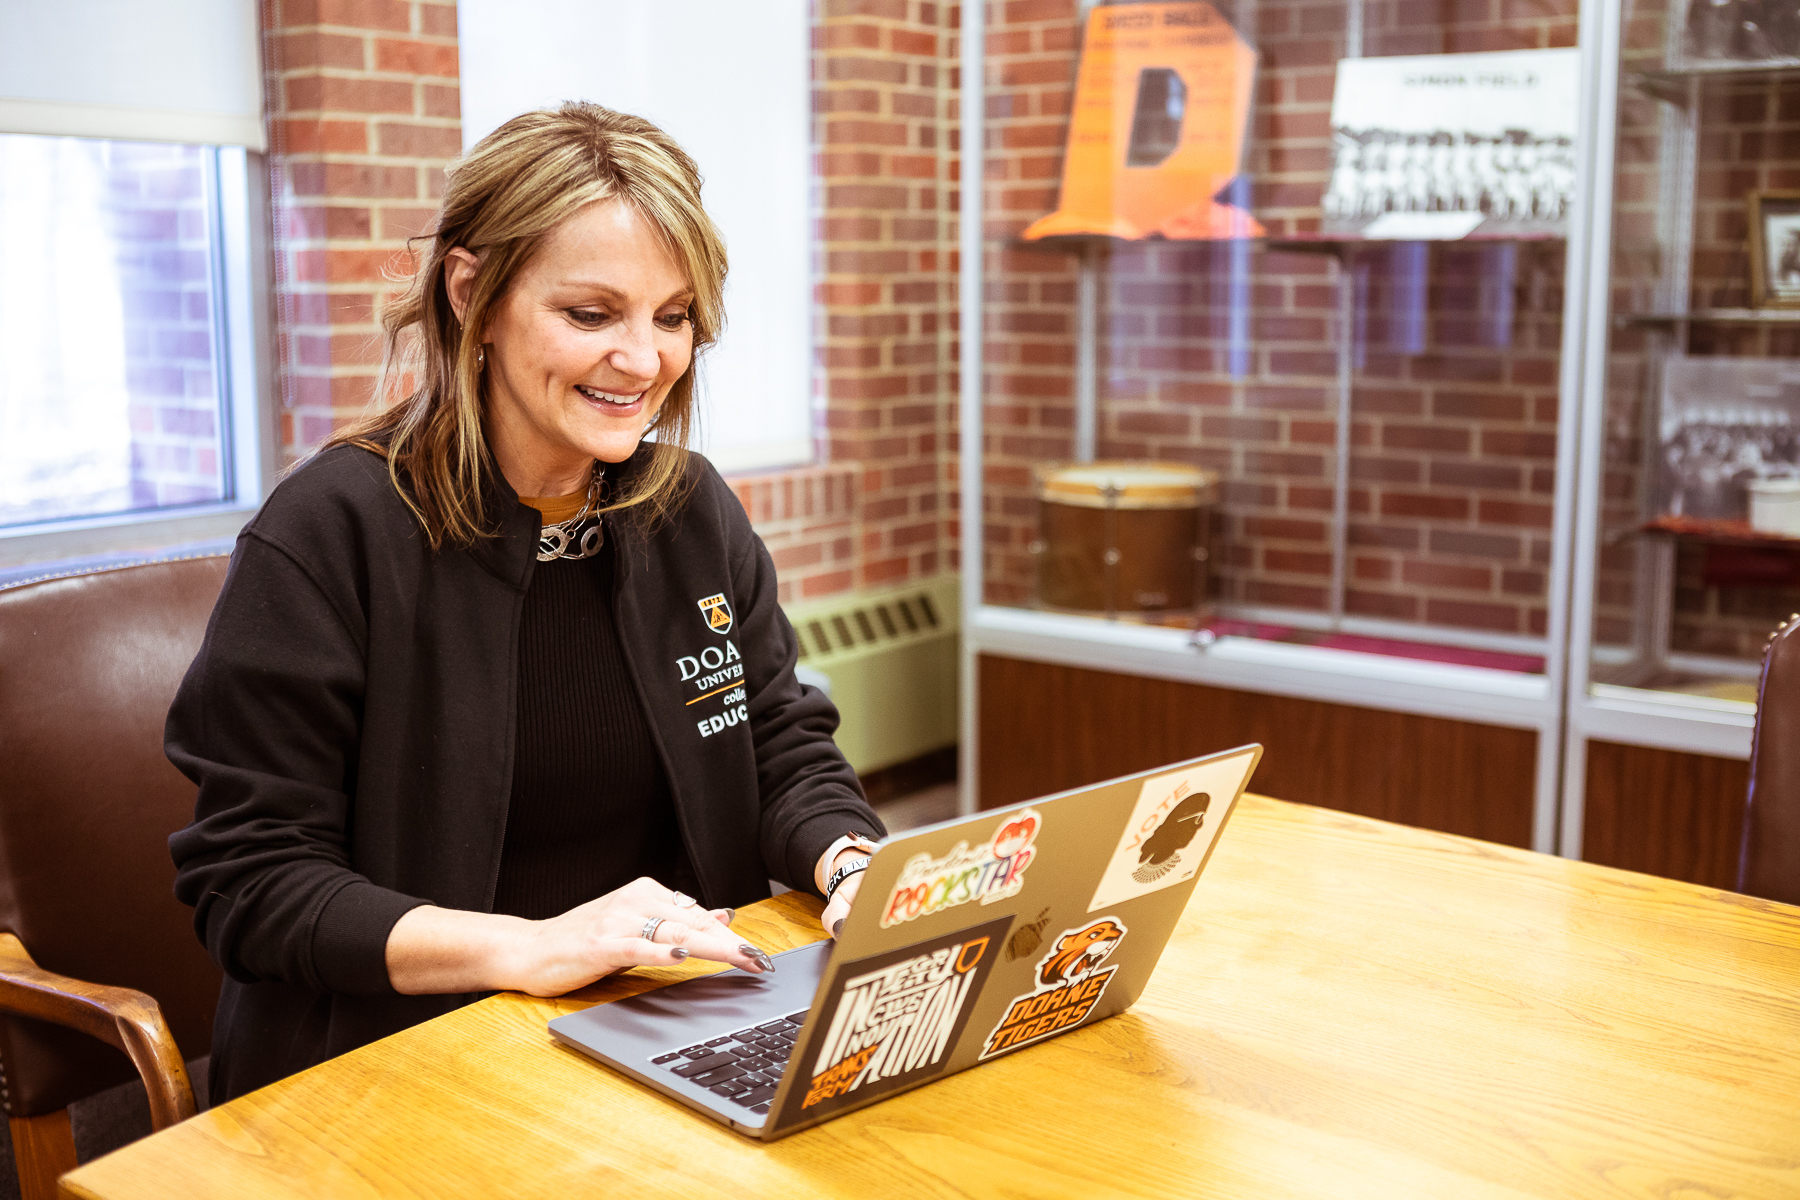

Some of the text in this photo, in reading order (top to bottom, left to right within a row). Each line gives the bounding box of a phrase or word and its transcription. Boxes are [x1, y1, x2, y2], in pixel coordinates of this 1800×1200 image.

[675, 639, 741, 682] DOA
[697, 704, 749, 738] EDUC
[1125, 779, 1191, 853] VOTE
[884, 849, 1032, 923] ROCKSTAR
[990, 999, 1095, 1053] TIGERS
[1003, 973, 1110, 1028] DOANE
